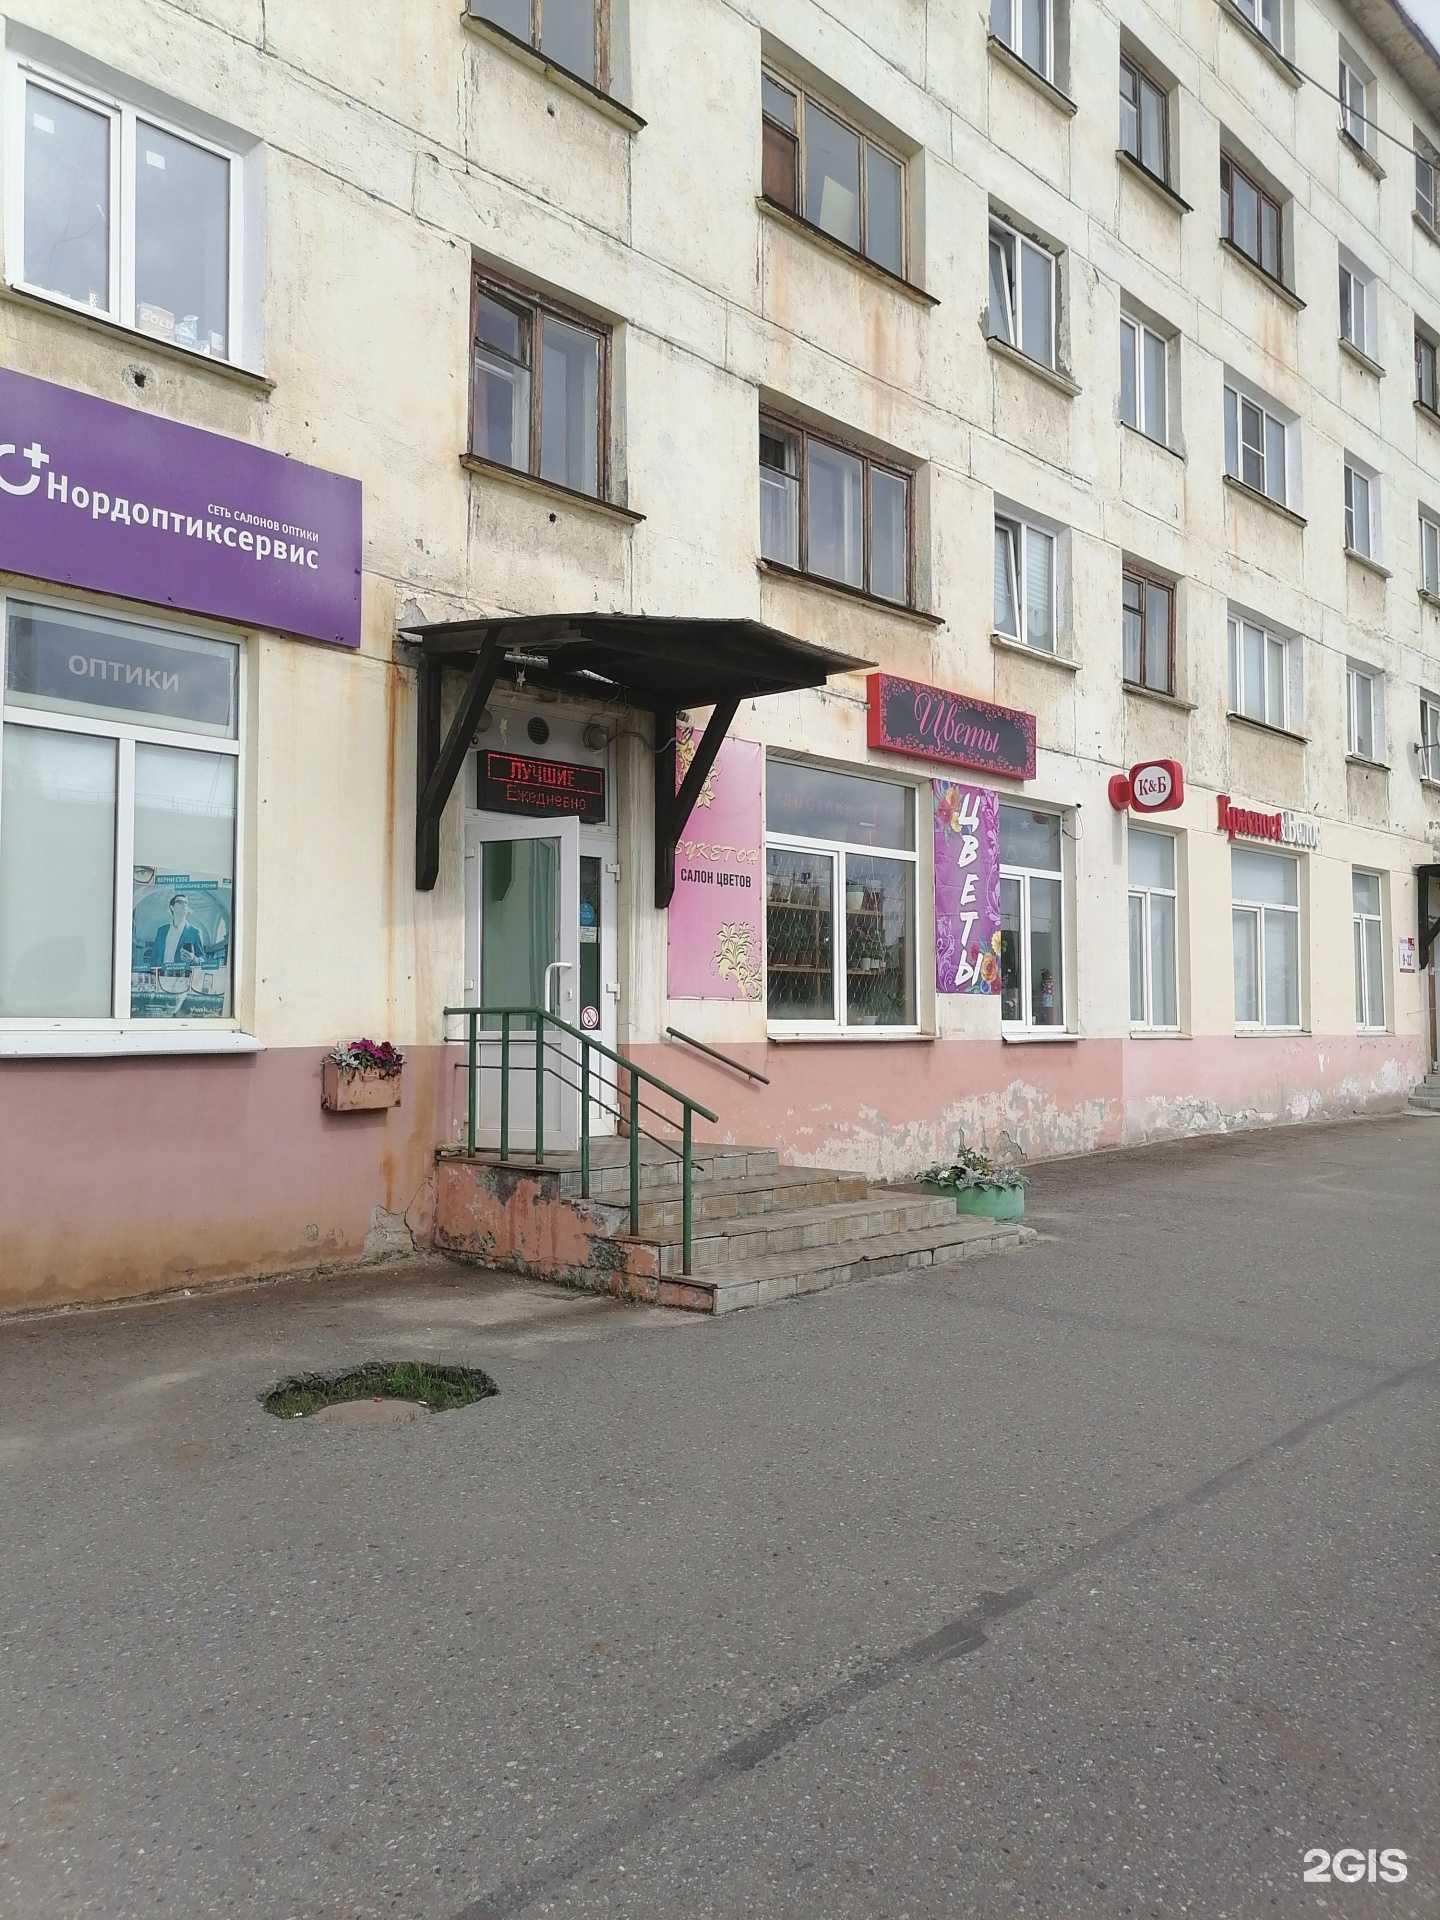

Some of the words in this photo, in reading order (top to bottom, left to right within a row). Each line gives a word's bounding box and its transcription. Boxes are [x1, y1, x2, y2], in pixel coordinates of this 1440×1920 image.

[48, 471, 319, 569] Нордоптиксервис
[207, 503, 231, 518] СЕТЬ
[234, 510, 280, 531] САЛОНОВ
[282, 523, 319, 543] ОПТИКИ
[68, 655, 180, 692] ОПТИКИ
[914, 692, 1000, 753] Цветы
[510, 761, 575, 786] ЛУЧШИЕ
[1138, 776, 1167, 796] К&Б
[681, 868, 713, 884] САЛОН
[716, 872, 751, 888] ЦВЕТОВ
[954, 793, 983, 987] ЦВЕТЫ
